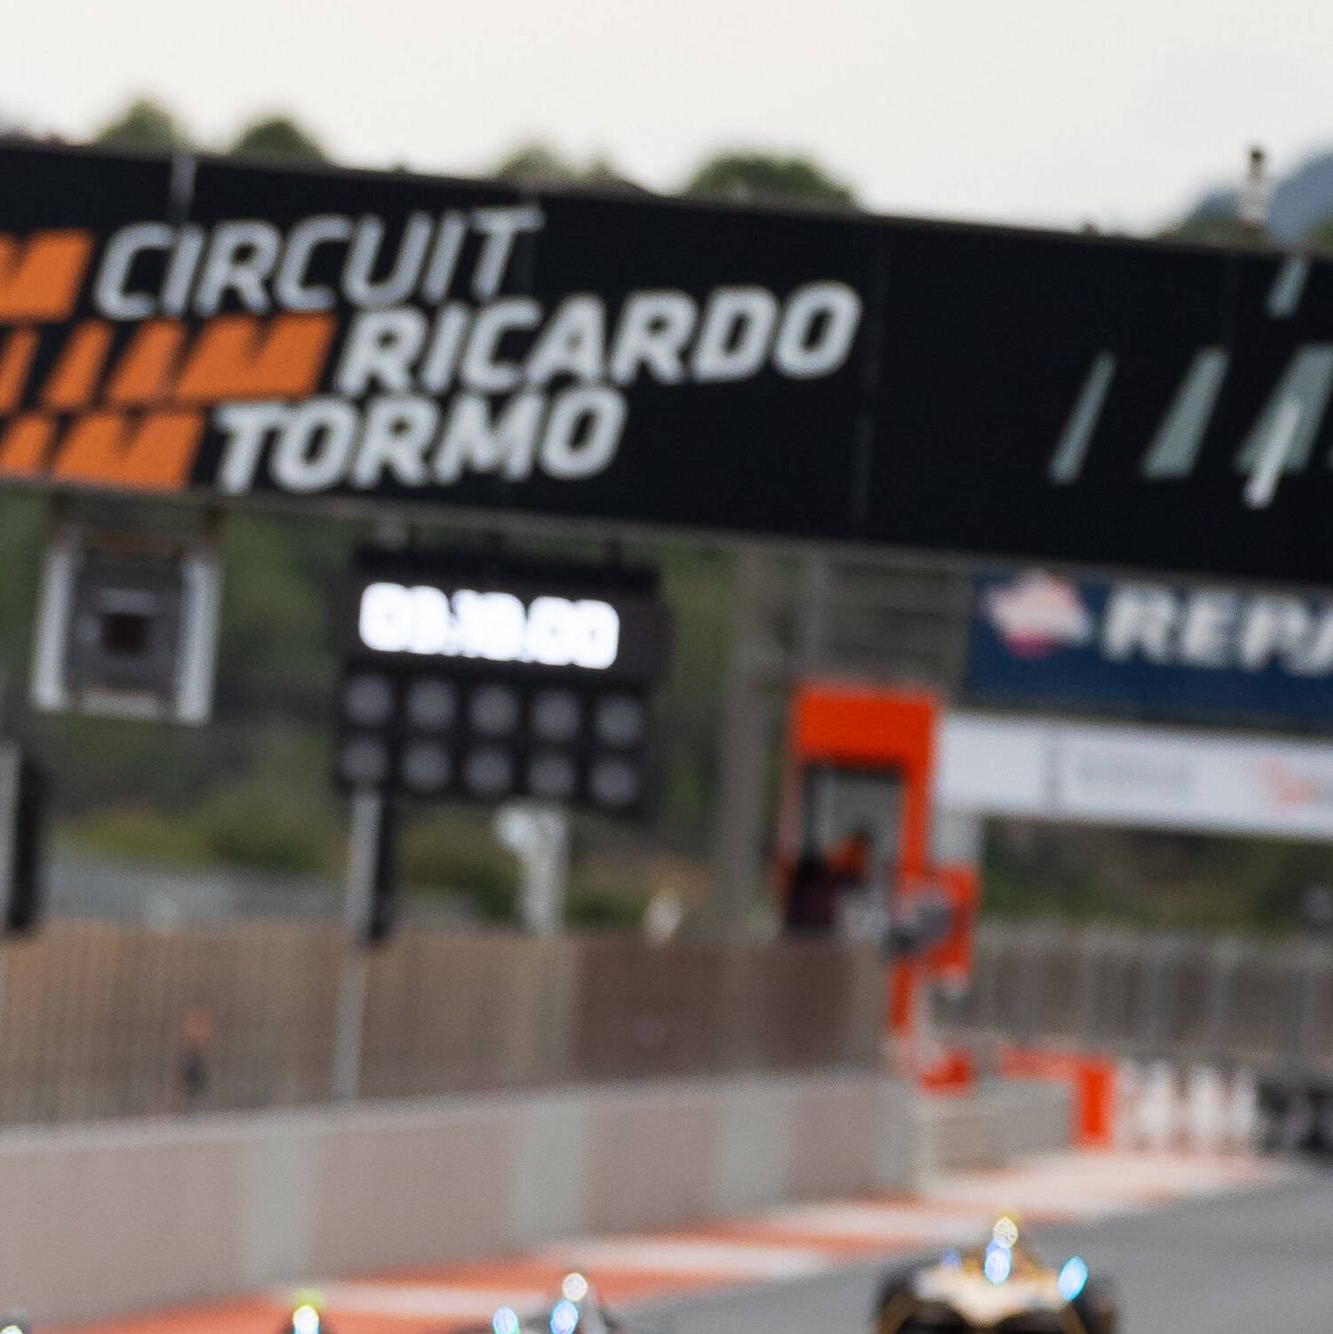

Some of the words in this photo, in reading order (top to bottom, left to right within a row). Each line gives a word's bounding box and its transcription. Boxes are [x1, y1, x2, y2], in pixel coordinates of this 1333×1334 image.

[95, 207, 543, 319] CIRCUIT
[337, 281, 862, 397] RICARDO
[215, 387, 628, 494] TORMO
